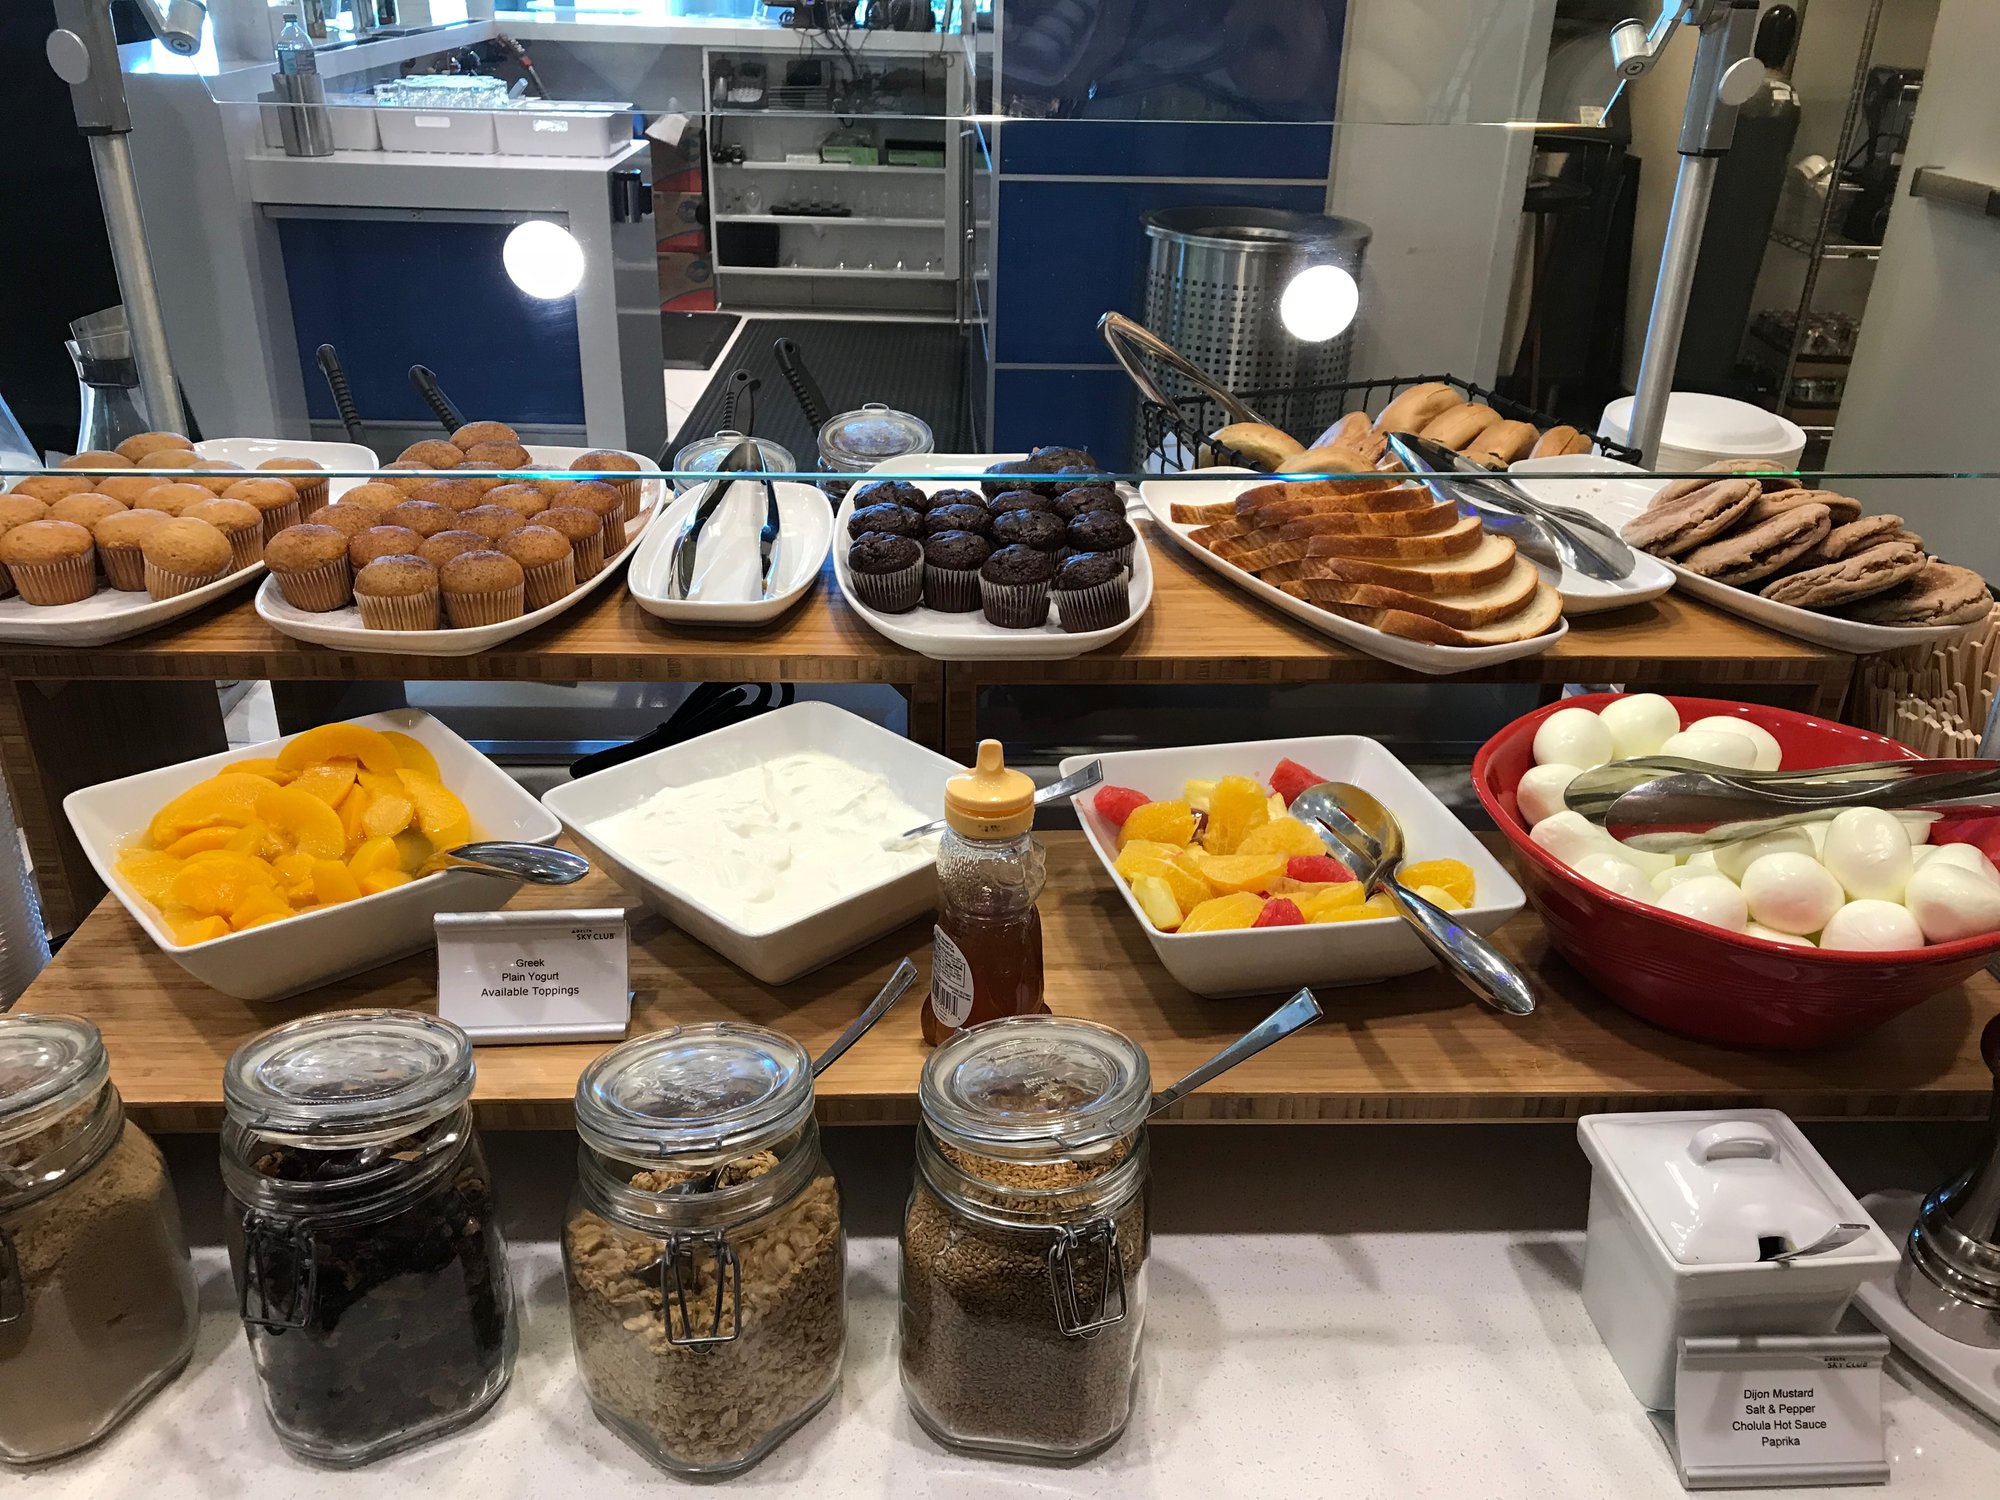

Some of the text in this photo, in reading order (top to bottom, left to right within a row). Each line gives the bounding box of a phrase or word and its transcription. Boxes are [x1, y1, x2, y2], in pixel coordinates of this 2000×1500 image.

[515, 958, 545, 968] Greek
[501, 971, 559, 983] Plain Yogurt
[481, 986, 580, 998] Available Toppings
[1743, 1388, 1814, 1401] Dijon Mustard
[1745, 1404, 1816, 1415] Salt & Pepper
[1732, 1420, 1827, 1431] Cholula Hot Sauce
[1761, 1436, 1801, 1448] Paprika
